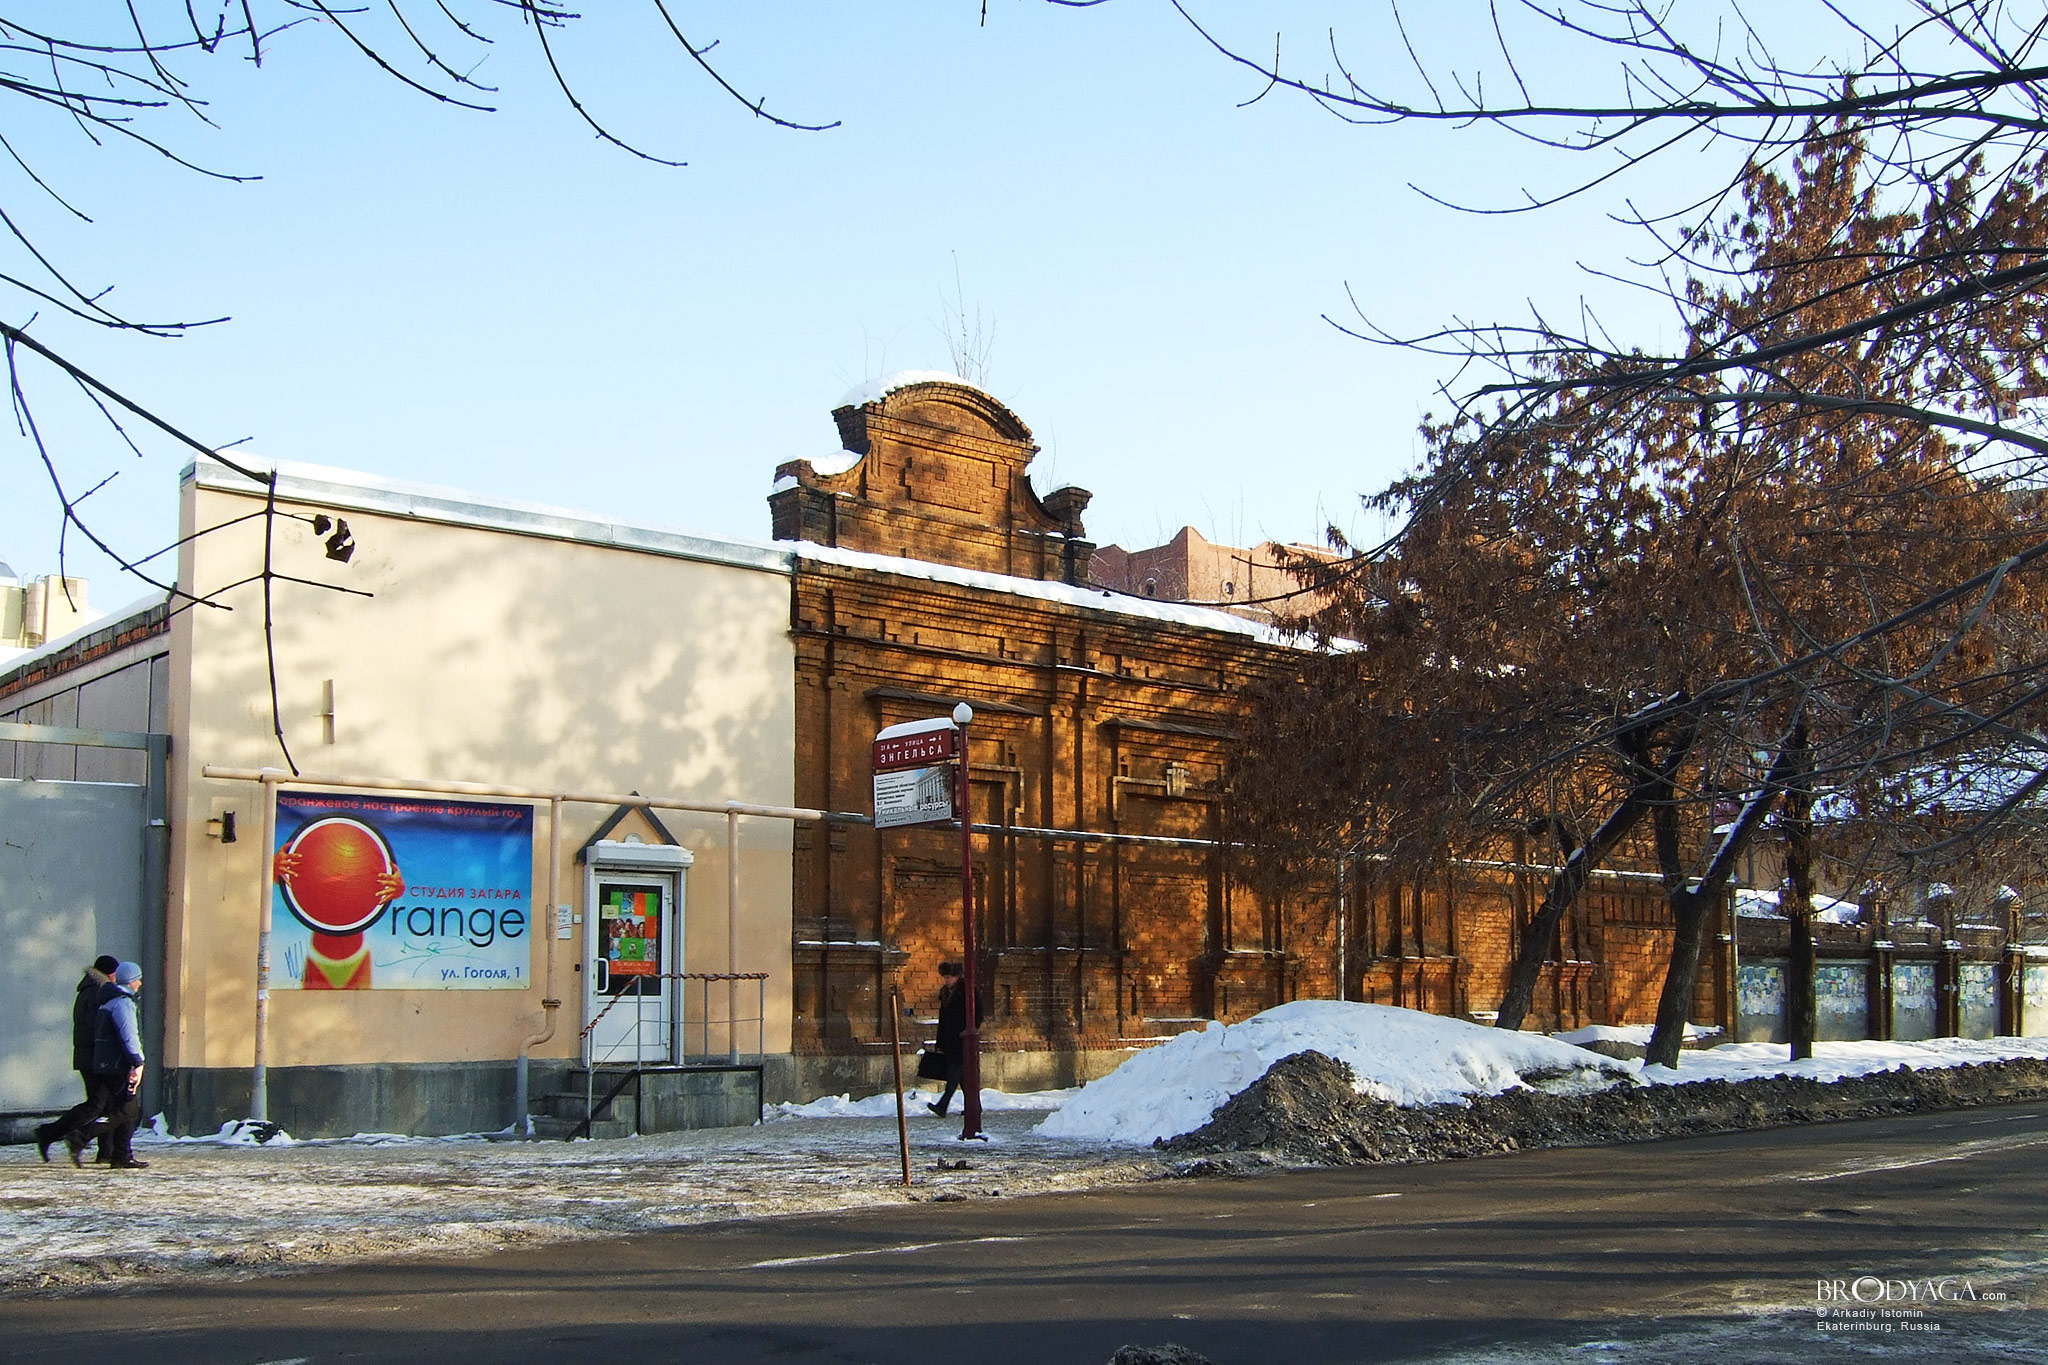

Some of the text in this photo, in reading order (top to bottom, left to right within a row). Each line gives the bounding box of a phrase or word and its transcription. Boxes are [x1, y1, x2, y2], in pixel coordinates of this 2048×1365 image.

[905, 738, 924, 747] УЛИЦА
[880, 744, 943, 764] ЭНГЕЛЬСА
[279, 796, 523, 819] оранжевое настроение круглый год
[410, 886, 522, 900] СТУДИЯ ЗАГАРА
[441, 966, 521, 981] ул. Гоголя, 1
